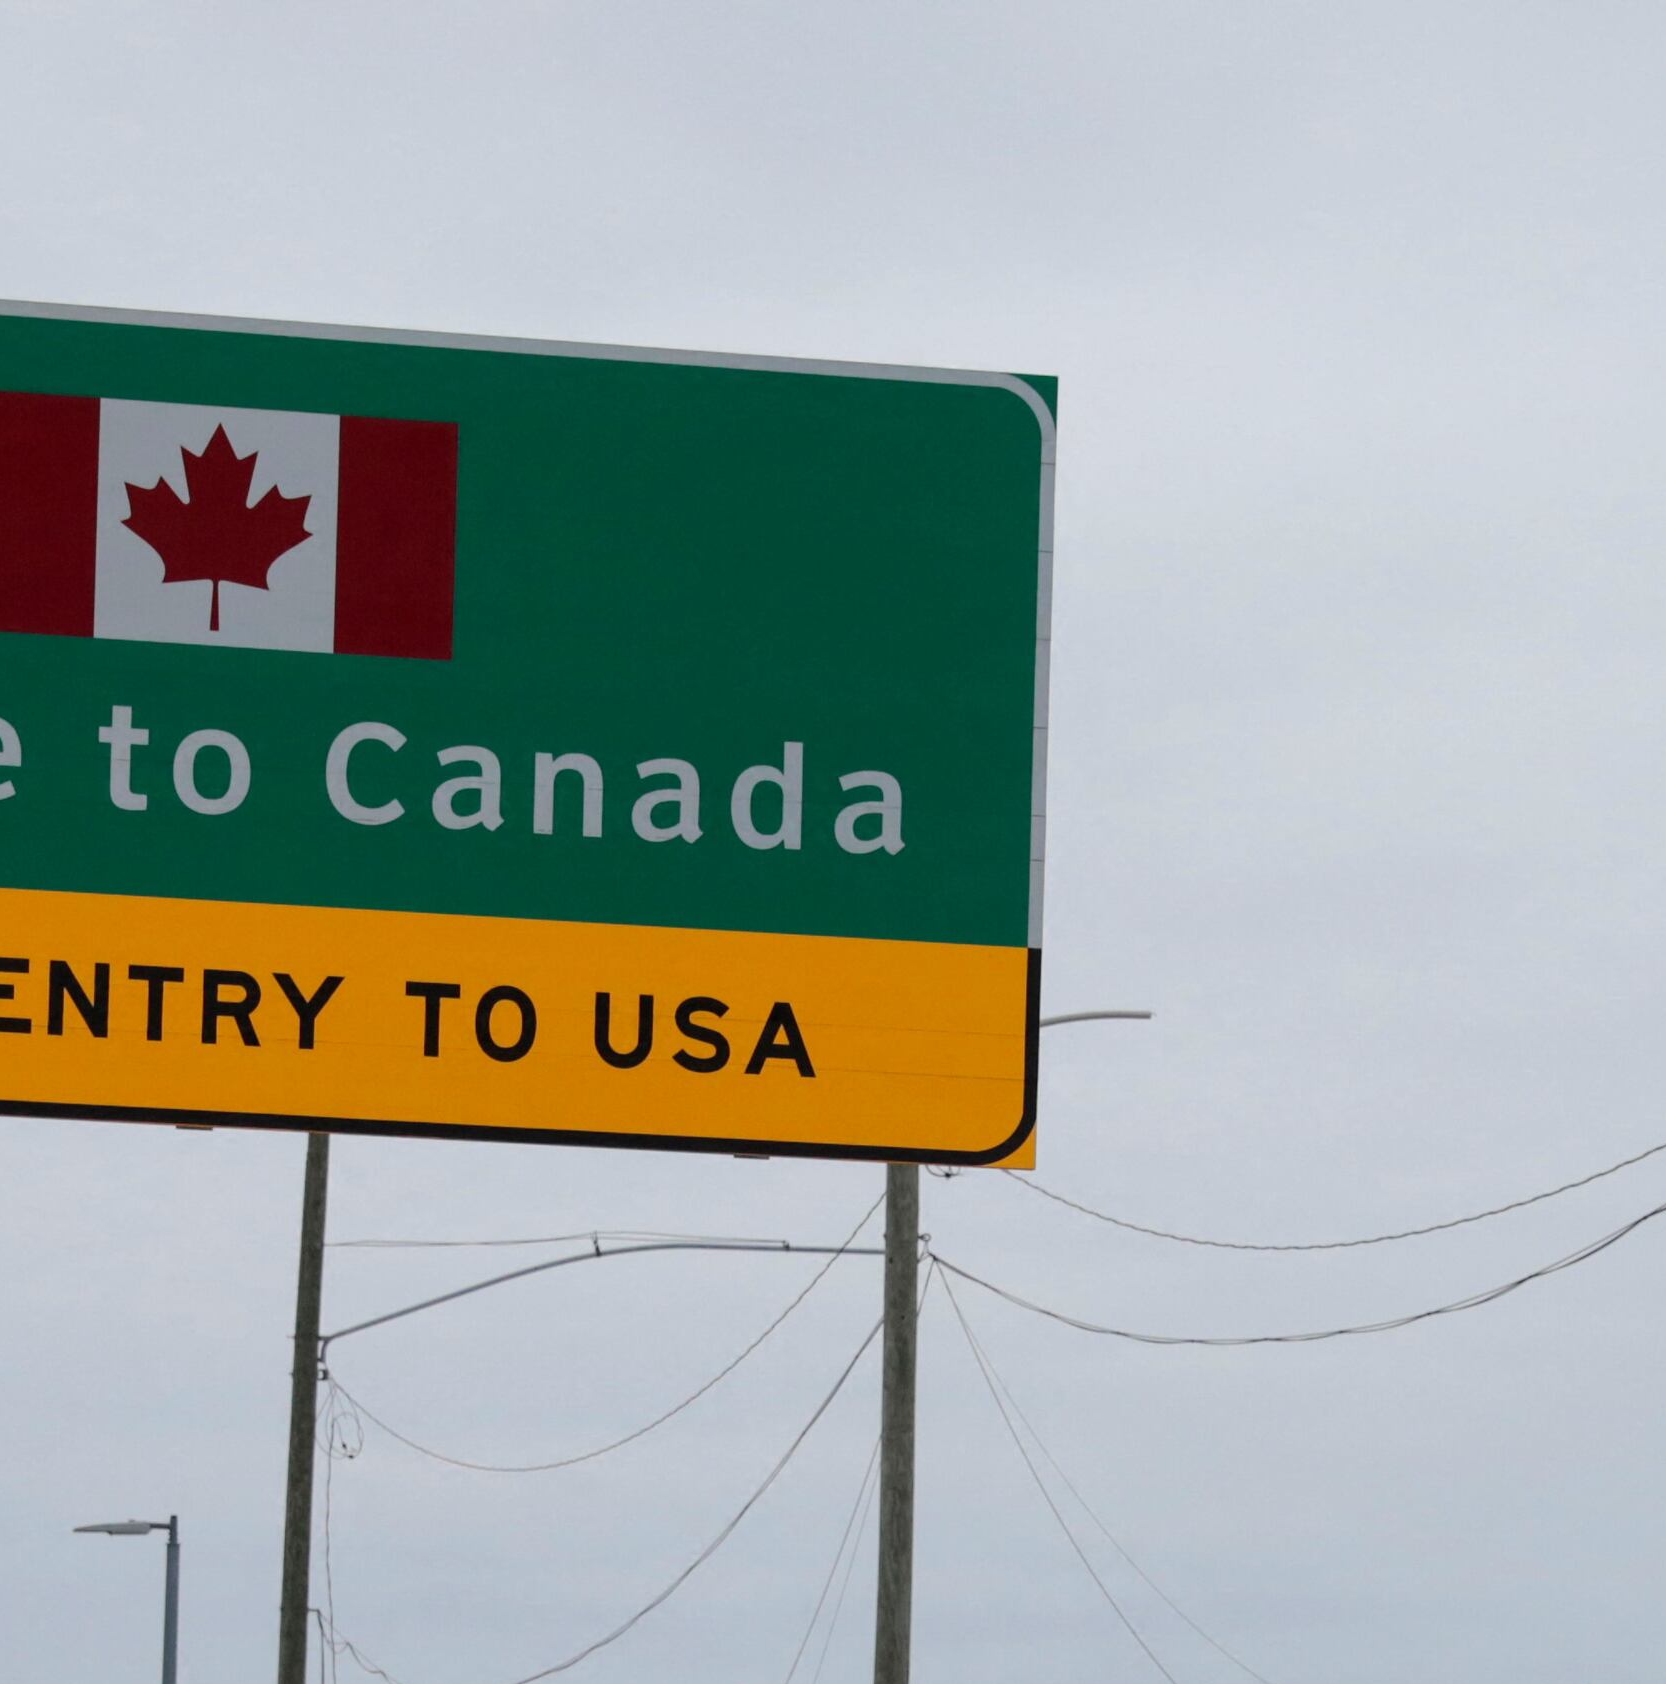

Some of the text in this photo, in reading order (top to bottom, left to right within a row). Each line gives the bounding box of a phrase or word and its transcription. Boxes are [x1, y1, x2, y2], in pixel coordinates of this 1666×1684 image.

[97, 703, 252, 817] to
[324, 720, 907, 857] Canada
[404, 979, 538, 1064] TO
[593, 990, 817, 1079] USA
